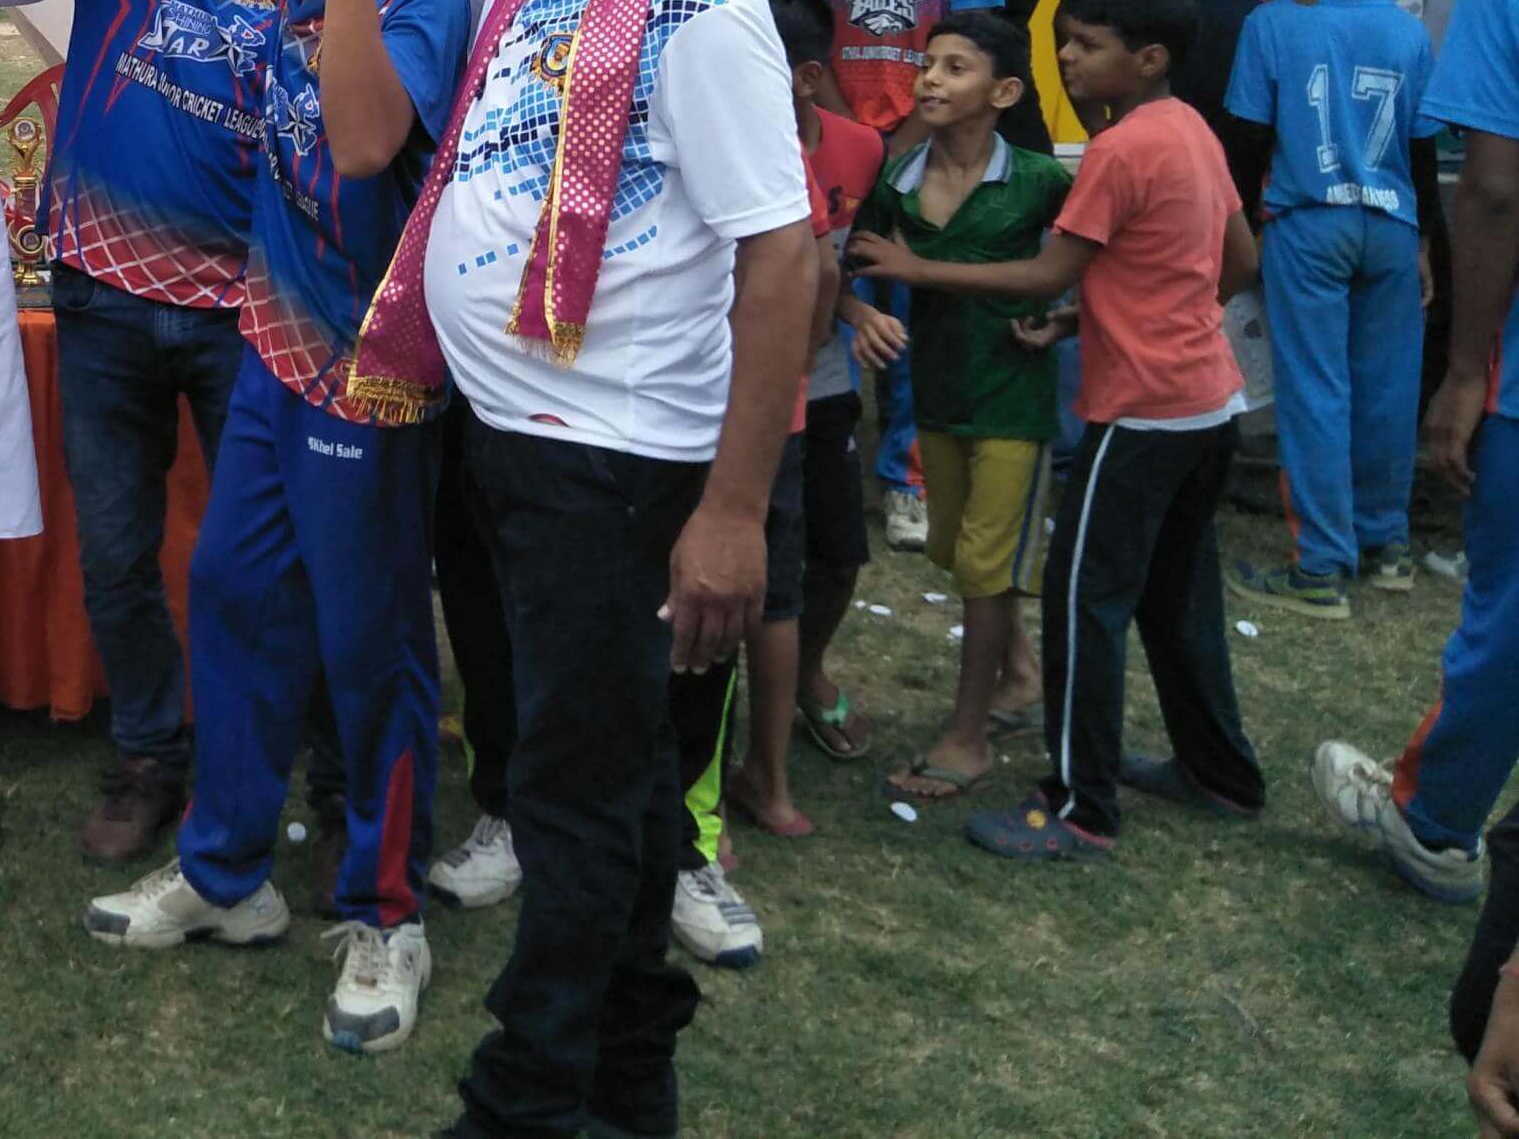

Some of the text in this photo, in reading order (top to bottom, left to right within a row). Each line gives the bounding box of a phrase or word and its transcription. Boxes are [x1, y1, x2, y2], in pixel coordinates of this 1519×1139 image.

[115, 51, 159, 91] MATHURA
[182, 90, 224, 123] CRICKET
[1307, 62, 1405, 173] 17
